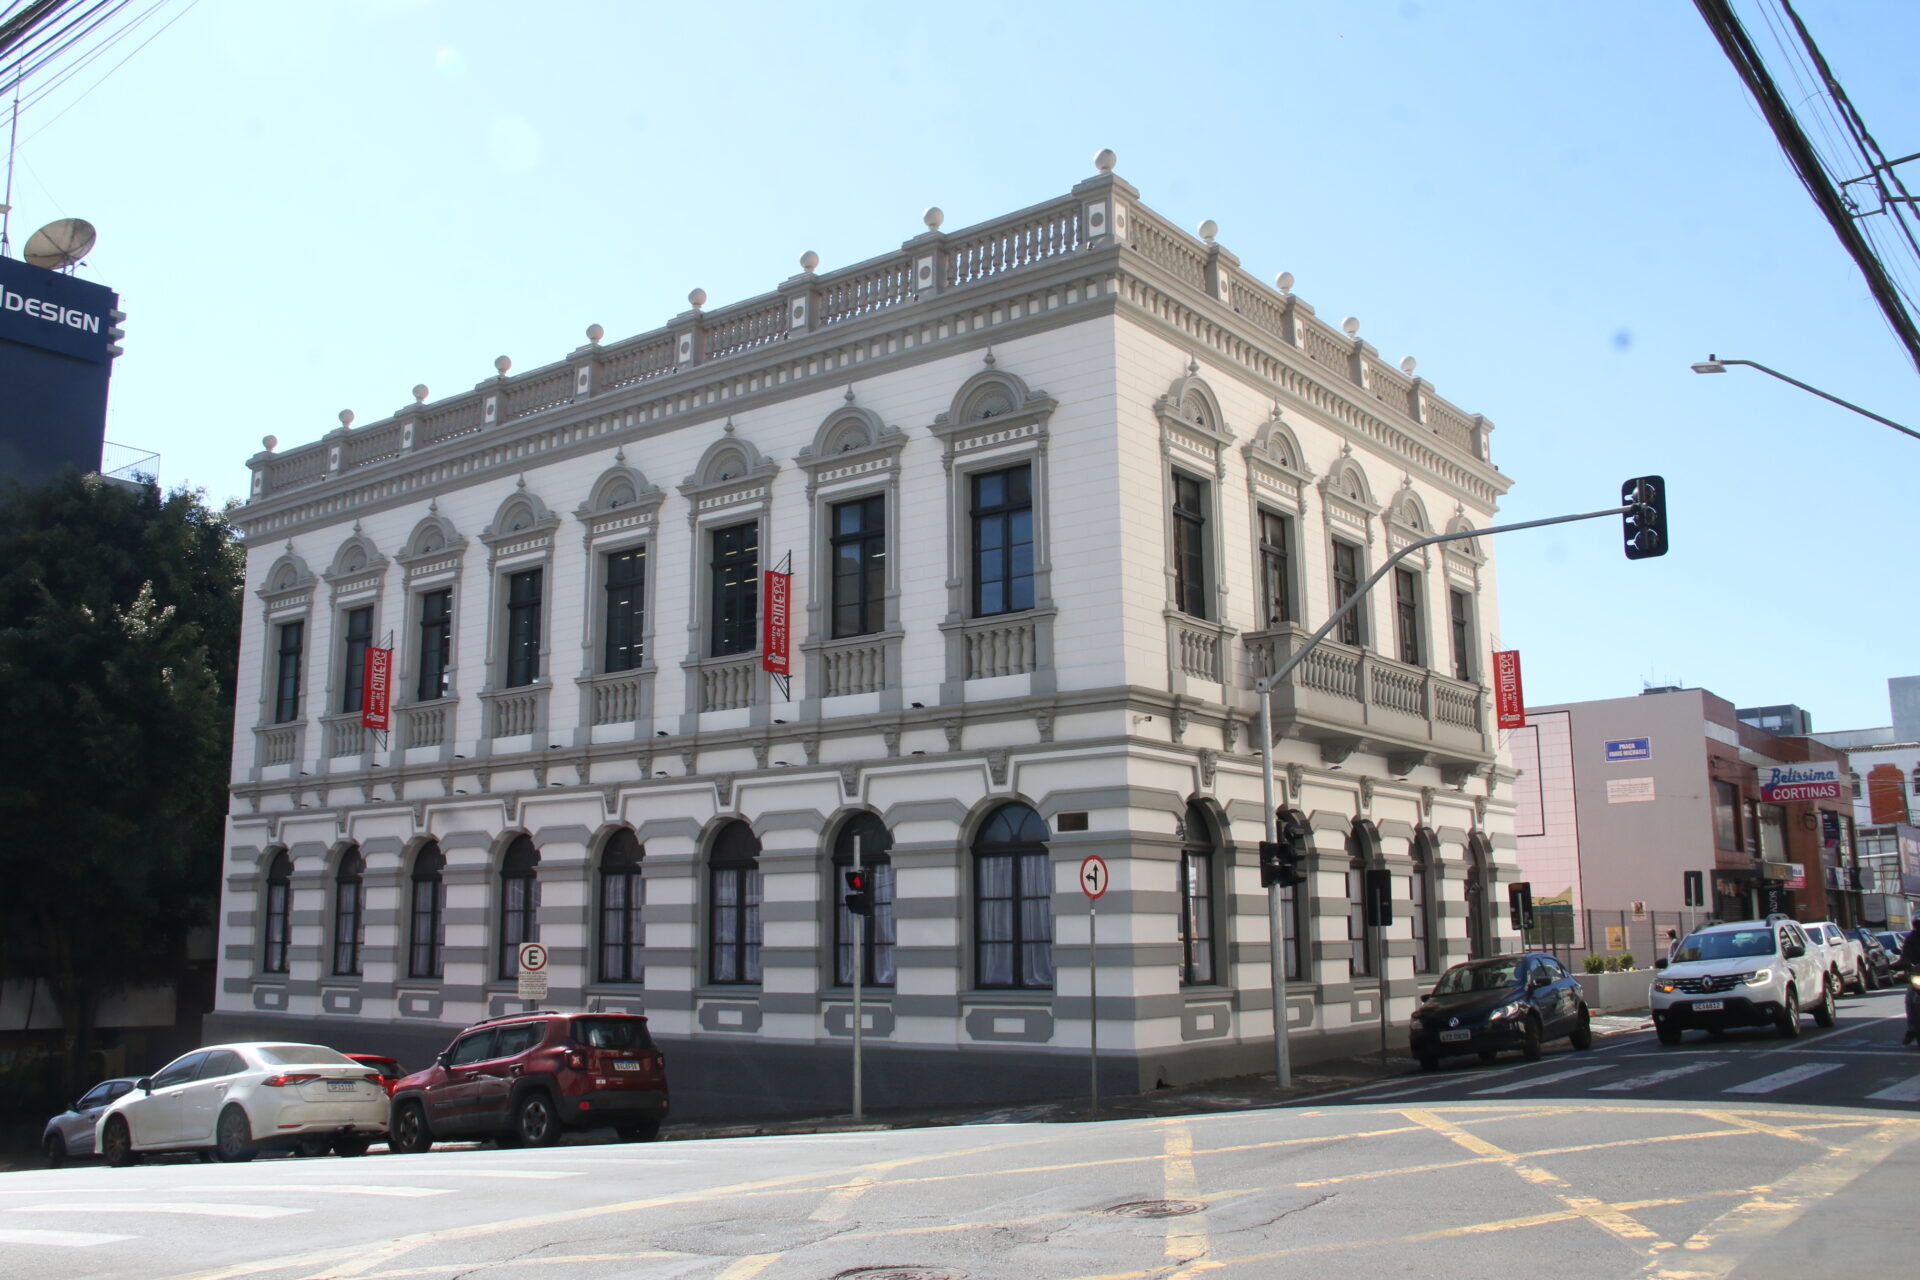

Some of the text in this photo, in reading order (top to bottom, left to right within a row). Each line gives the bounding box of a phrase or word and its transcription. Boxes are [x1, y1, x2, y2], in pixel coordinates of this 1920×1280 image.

[5, 291, 100, 334] DESIGN
[1772, 785, 1836, 800] CORTINAS
[528, 949, 539, 966] E
